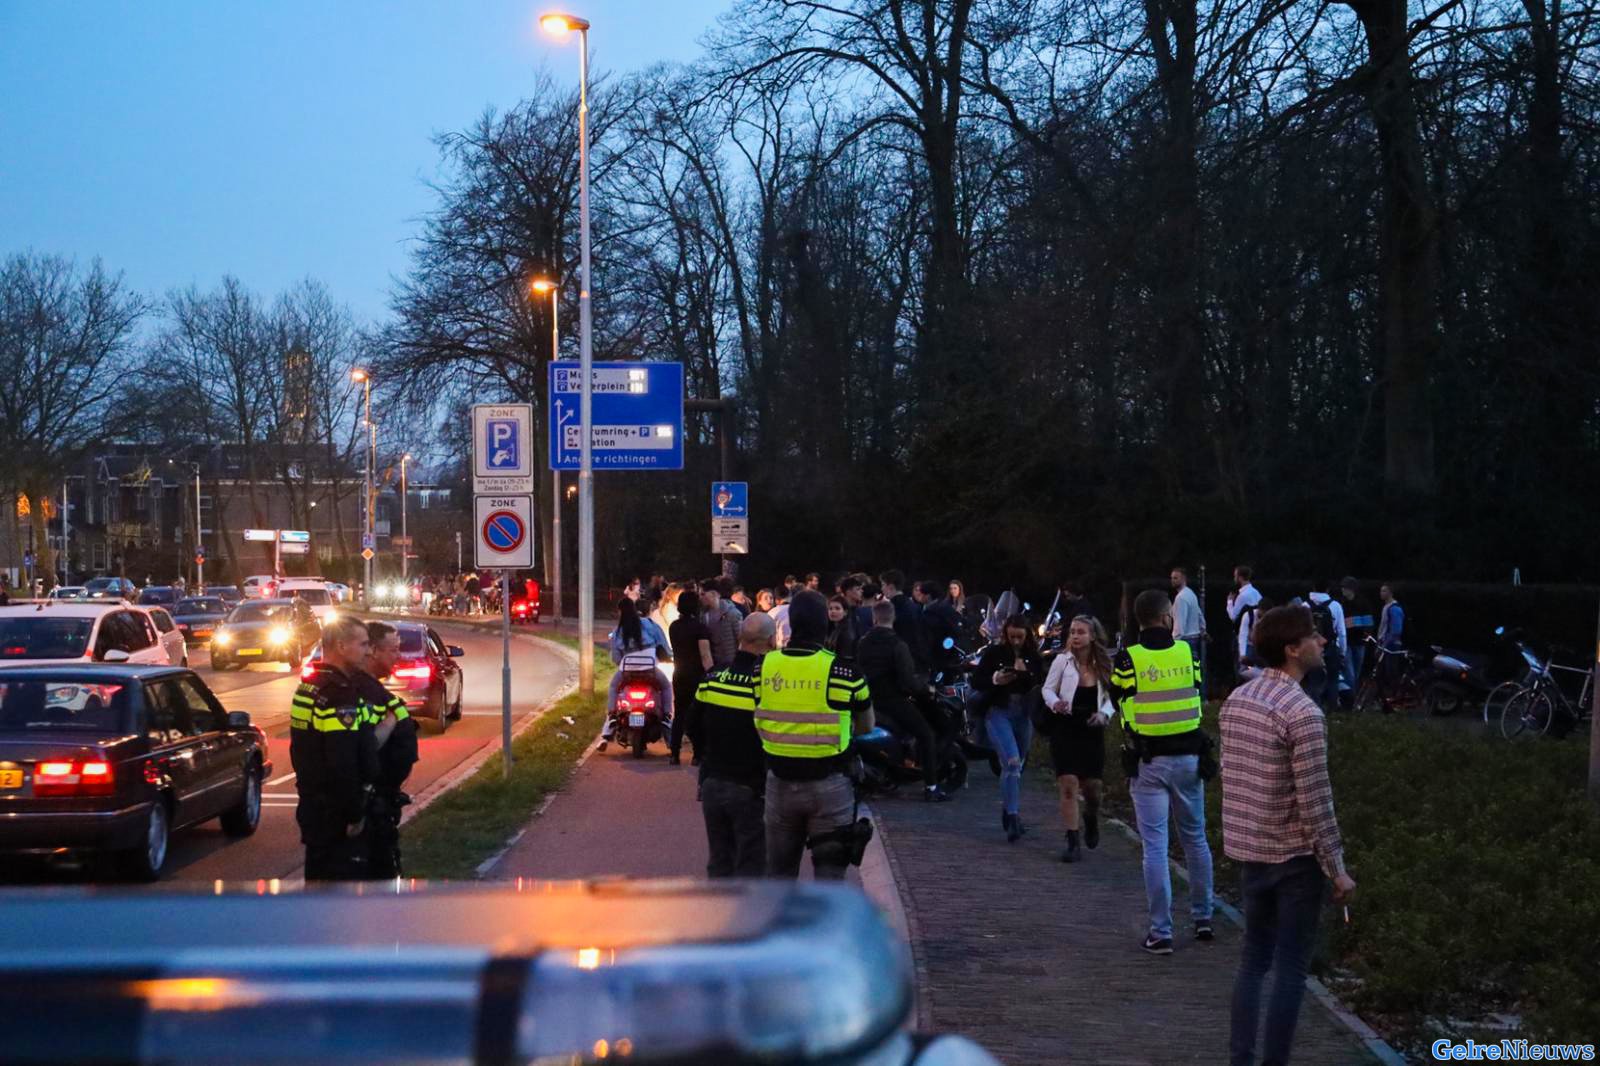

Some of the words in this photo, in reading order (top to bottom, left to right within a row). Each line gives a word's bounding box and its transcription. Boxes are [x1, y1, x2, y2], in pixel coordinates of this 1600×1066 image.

[569, 382, 625, 391] Veerplein
[490, 409, 515, 417] ZONE
[493, 423, 511, 448] P
[603, 454, 657, 465] richtingen
[490, 499, 516, 507] ZONE
[1140, 664, 1192, 681] POLITIE
[763, 674, 822, 691] POLITIE
